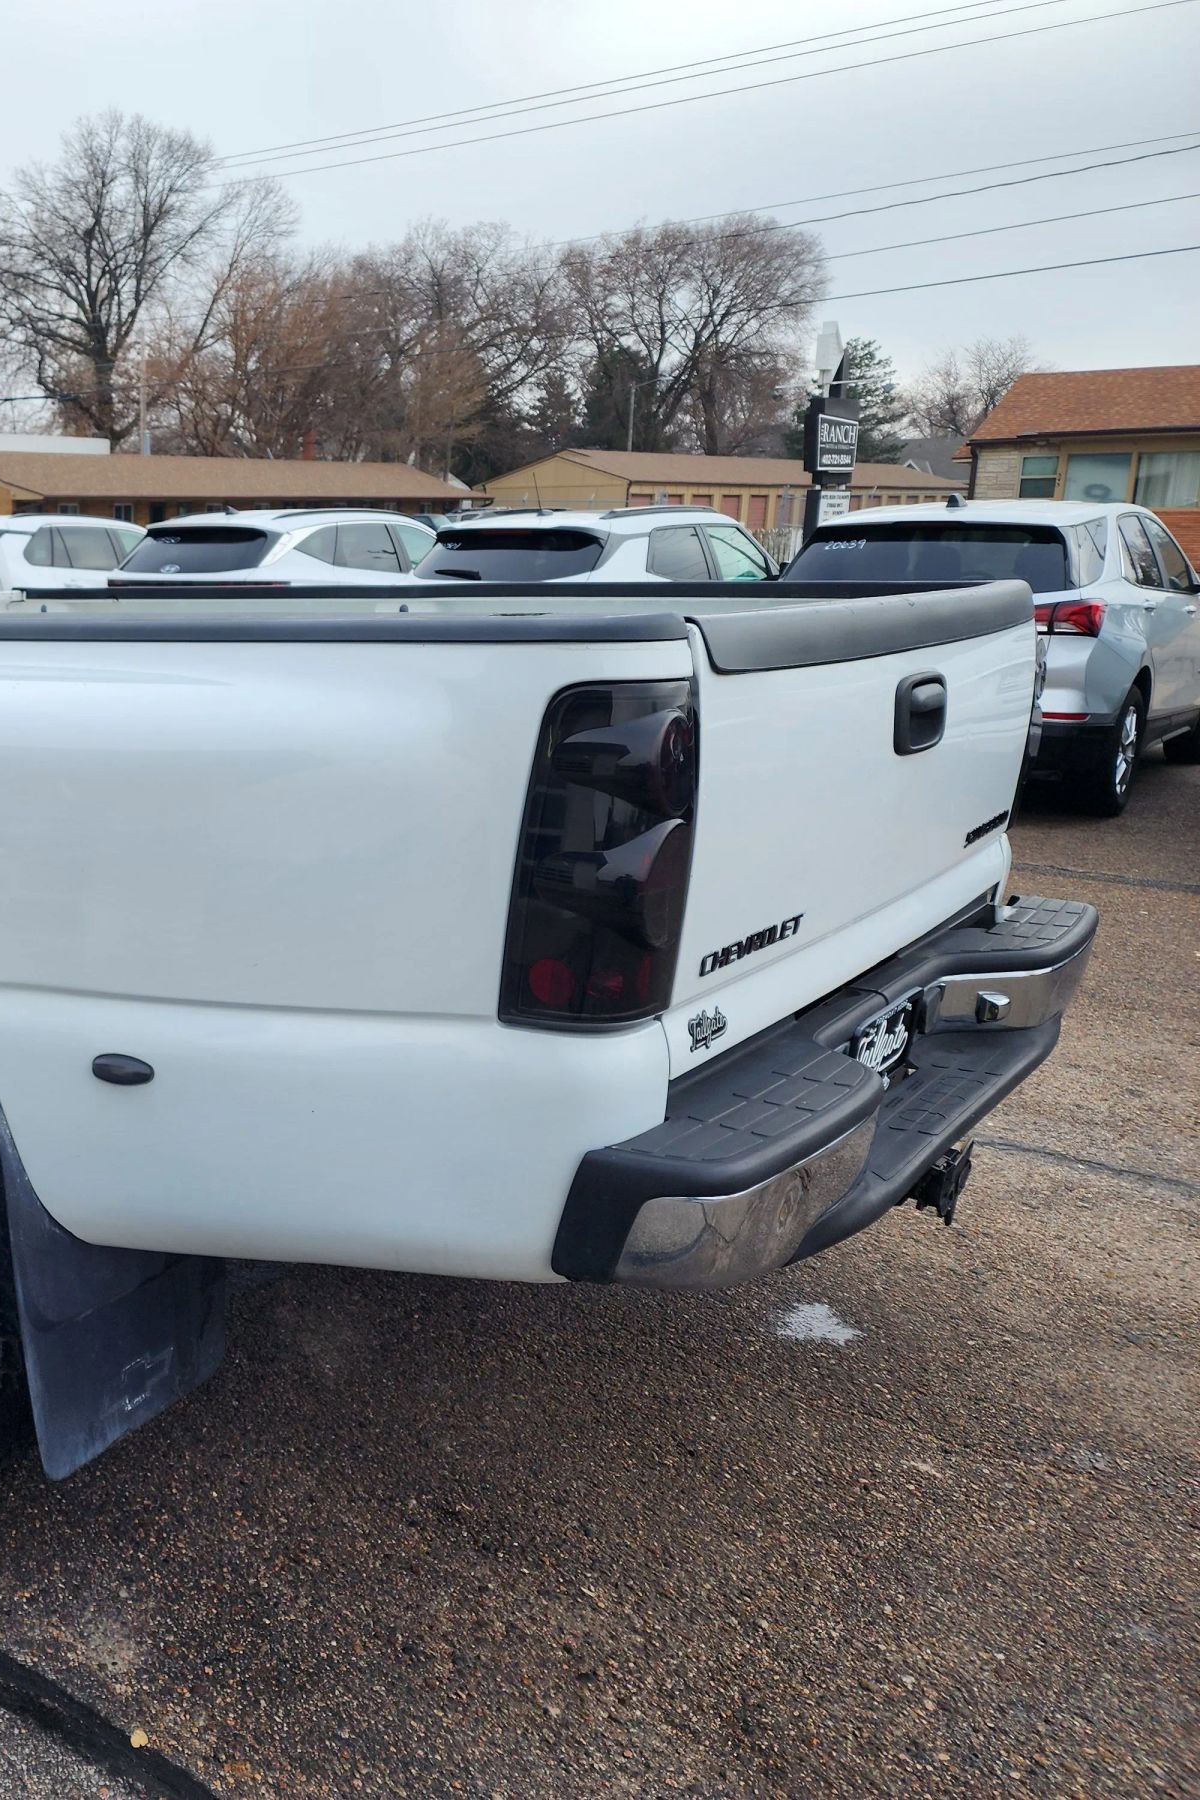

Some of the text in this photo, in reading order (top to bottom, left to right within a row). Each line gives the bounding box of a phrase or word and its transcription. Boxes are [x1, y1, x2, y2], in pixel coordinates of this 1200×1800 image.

[822, 423, 857, 444] RANCH
[699, 913, 805, 977] CHEVROLET
[688, 1006, 728, 1053] Tailgate
